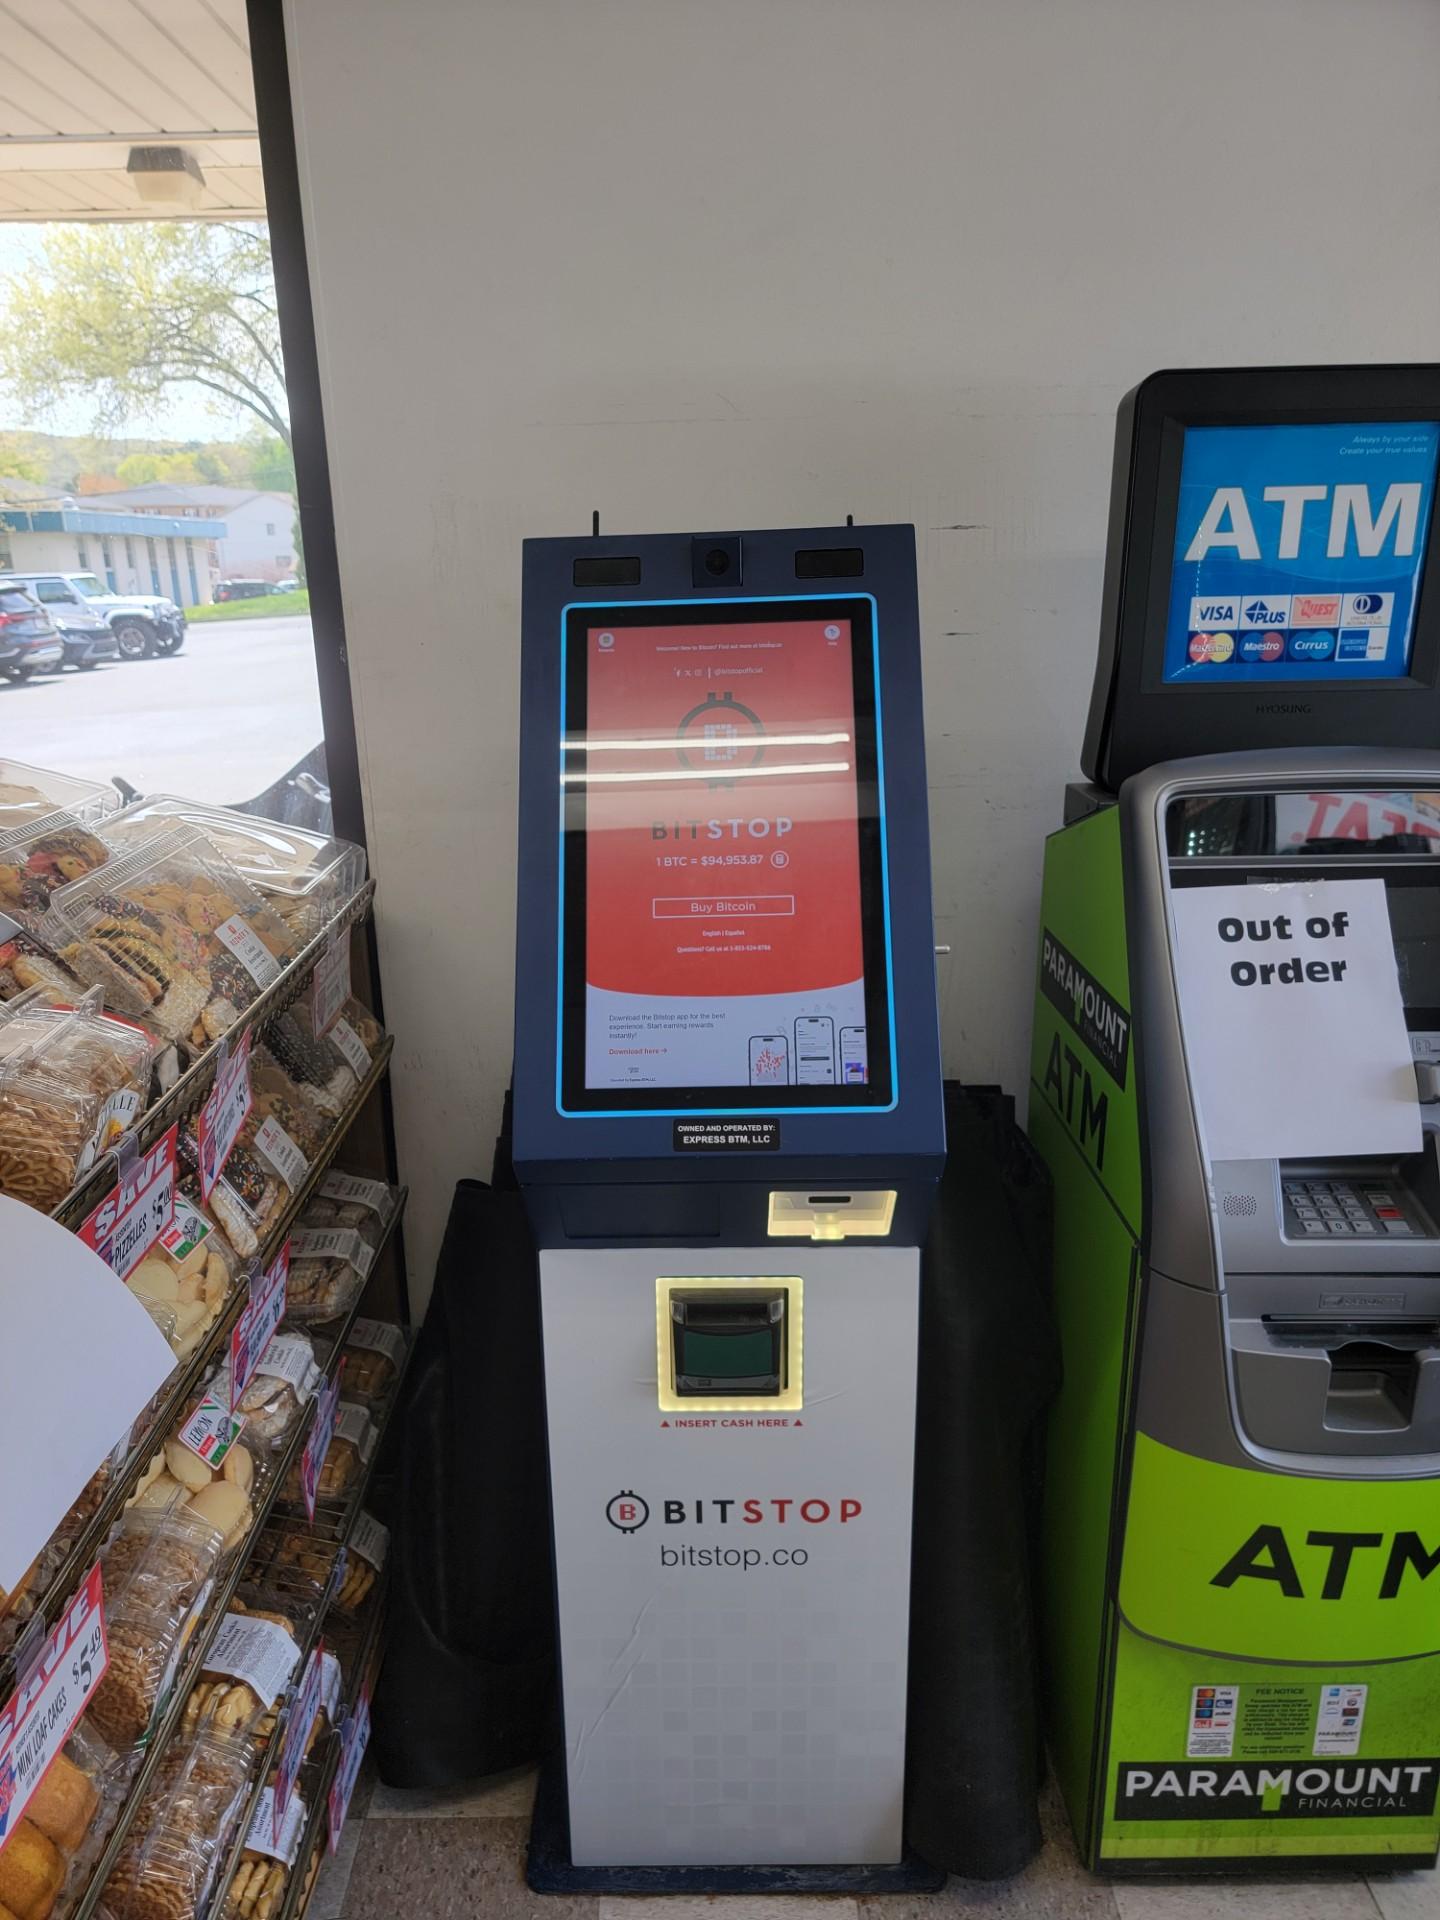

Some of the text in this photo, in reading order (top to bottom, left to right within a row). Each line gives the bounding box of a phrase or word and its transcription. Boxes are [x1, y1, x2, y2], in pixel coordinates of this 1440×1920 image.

[1352, 435, 1380, 444] Always
[1382, 436, 1391, 444] by
[1340, 447, 1364, 455] Create
[1366, 447, 1384, 455] your
[1385, 446, 1401, 454] true
[1183, 482, 1422, 562] ATM
[1200, 605, 1234, 621] VISA
[1254, 610, 1286, 624] PLUS
[1243, 641, 1280, 651] Maestro
[1294, 639, 1329, 651] Cirrus
[1255, 704, 1312, 714] HYOSUNG
[651, 817, 793, 841] BITSTOP
[664, 856, 688, 867] BTC
[700, 854, 764, 867] $94,953.87
[690, 901, 756, 914] Buy Bitcoin
[1217, 911, 1350, 944] Out of
[1230, 957, 1348, 988] Order
[1043, 937, 1128, 1054] PARAMOUNT
[608, 1012, 726, 1022] Download the Bitstop app for the best
[646, 1022, 662, 1030] Start
[663, 1022, 688, 1031] earning
[688, 1021, 715, 1029] rewards
[608, 1047, 659, 1056] Download here
[1044, 1031, 1109, 1173] ATM
[677, 1123, 776, 1133] OWNED AND OPERATED BY:
[682, 1135, 771, 1145] EXPRESS BTM, LLC
[95, 1138, 169, 1241] SAVE
[114, 1212, 147, 1268] PIZZELLES
[187, 1413, 213, 1447] LEMON
[674, 1418, 789, 1428] INSERT CASH HERE
[663, 1498, 863, 1525] BITSTOP
[660, 1543, 809, 1571] bitstop.co
[1208, 1523, 1440, 1601] ATM
[17, 1750, 33, 1783] MINI
[32, 1719, 48, 1756] LOAF
[48, 1686, 68, 1731] CAKES
[1125, 1766, 1432, 1798] PARAMOUNT
[1298, 1796, 1407, 1810] FINANCIAL
